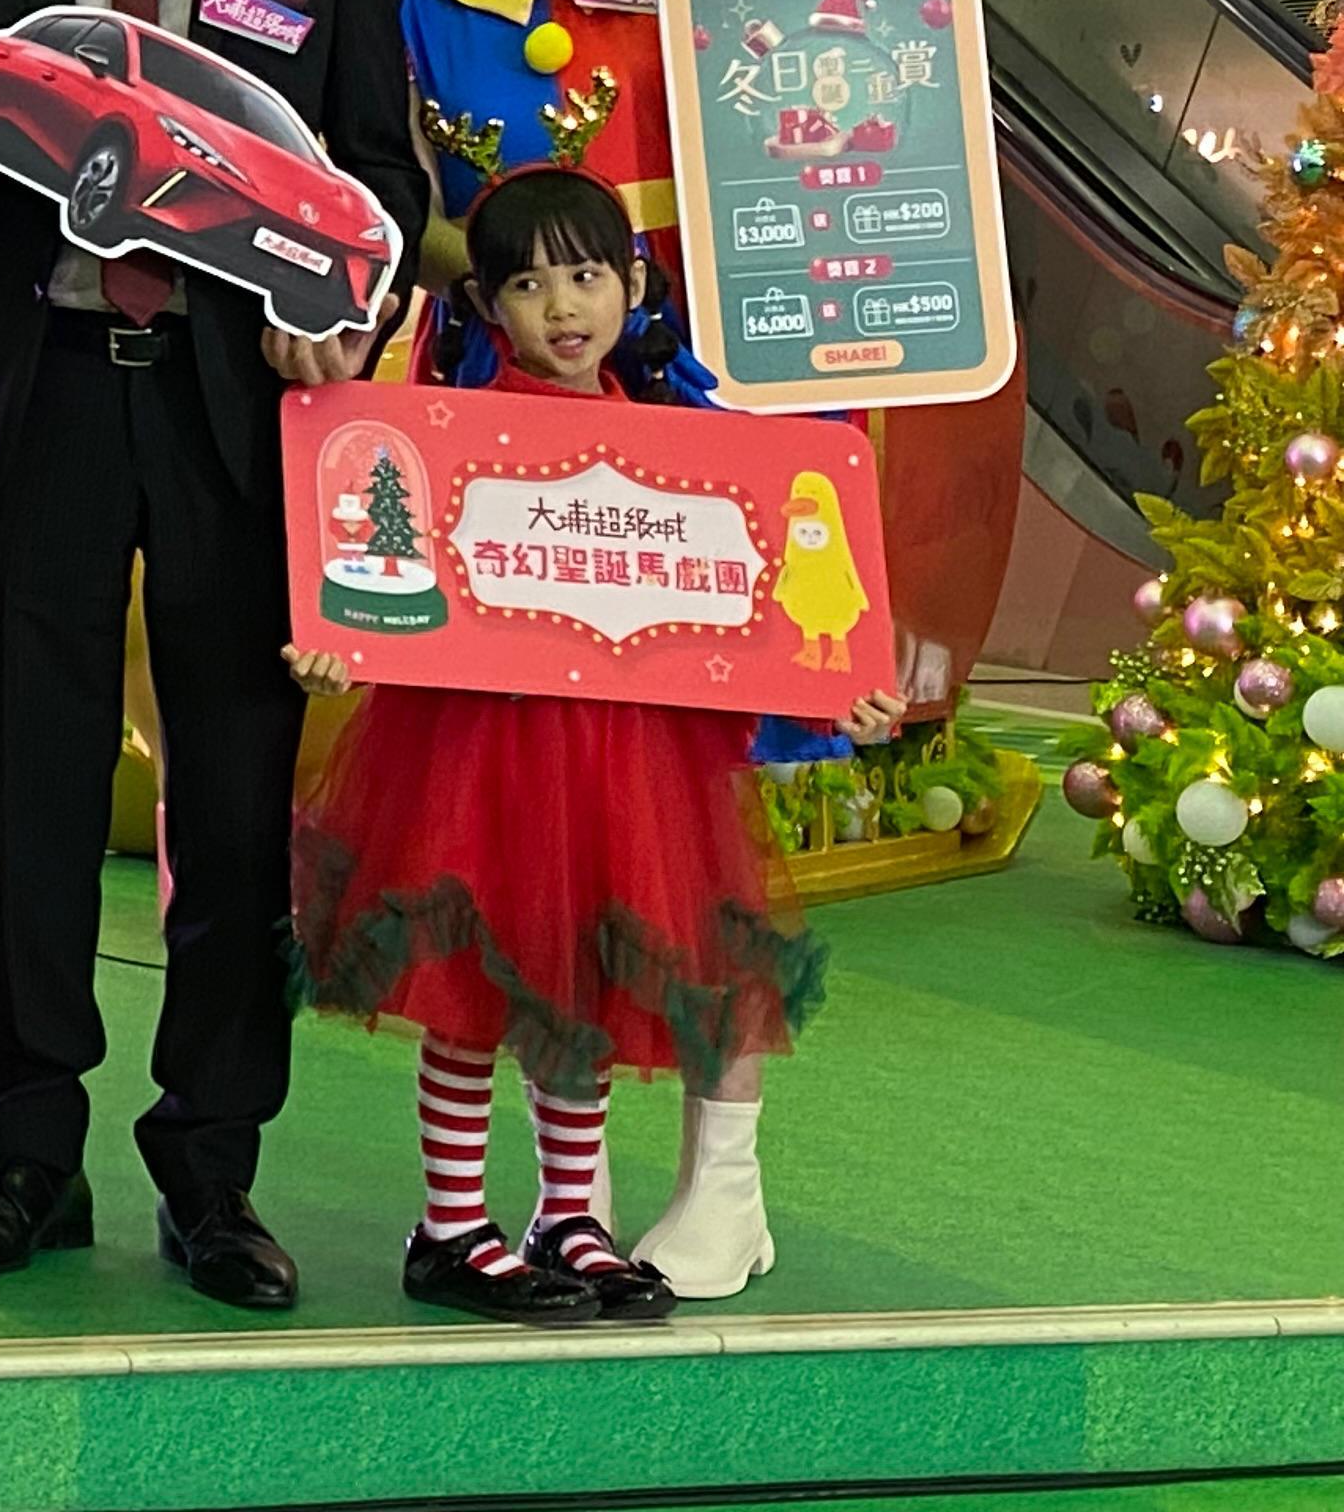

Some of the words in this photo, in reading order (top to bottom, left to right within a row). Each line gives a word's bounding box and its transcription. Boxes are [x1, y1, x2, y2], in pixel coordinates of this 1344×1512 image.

[738, 223, 796, 245] $3,000
[747, 314, 805, 336] $6,000
[824, 345, 887, 365] SHARE!
[527, 497, 688, 543] 大埔超級城
[472, 538, 751, 599] 奇幻聖誕馬戲團
